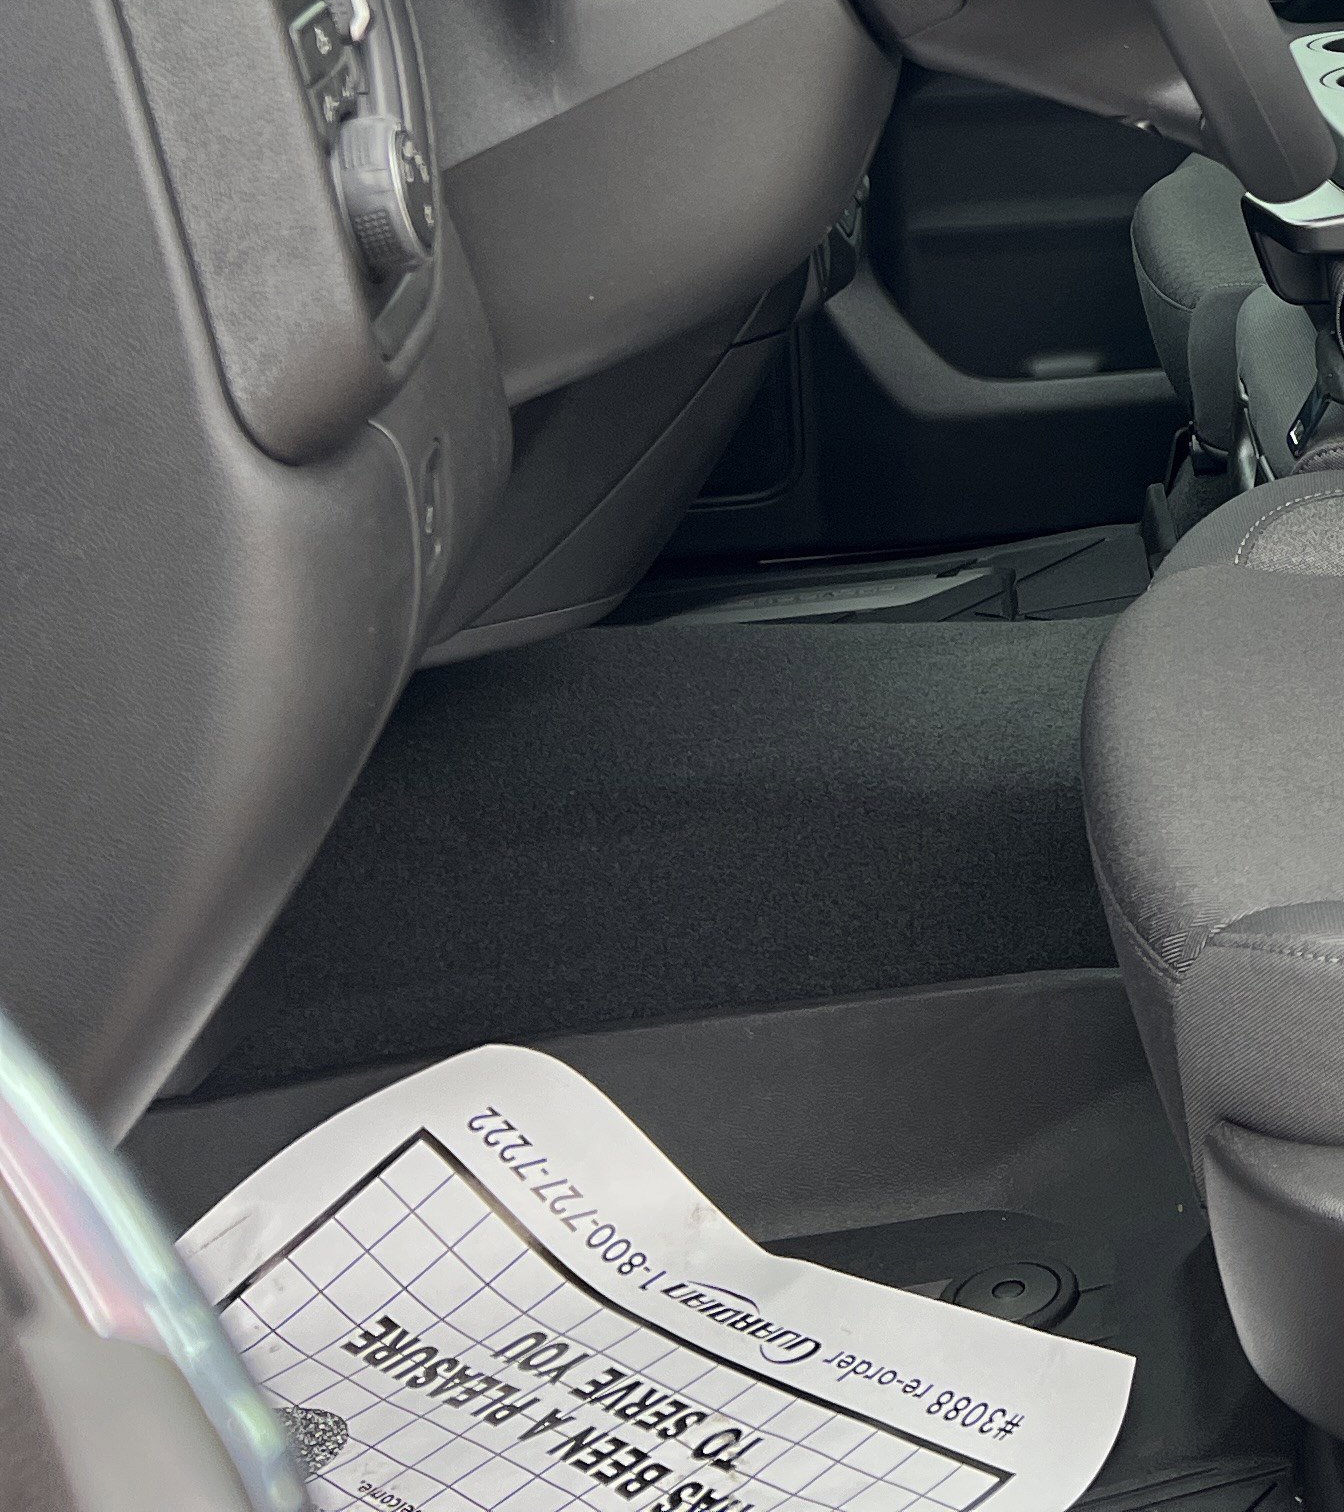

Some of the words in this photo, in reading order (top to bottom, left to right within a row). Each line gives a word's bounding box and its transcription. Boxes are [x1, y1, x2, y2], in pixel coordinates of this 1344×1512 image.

[467, 1106, 667, 1291] 1-800-727-7222
[340, 1314, 542, 1427] PLEASURE
[489, 1331, 590, 1384] YOU
[821, 1350, 935, 1399] re-order
[516, 1408, 577, 1442] A
[568, 1366, 711, 1440] SERVE
[926, 1389, 1025, 1440] #3088
[546, 1425, 674, 1501] BEEN
[691, 1427, 764, 1473] TO
[356, 1479, 422, 1512] elcome.
